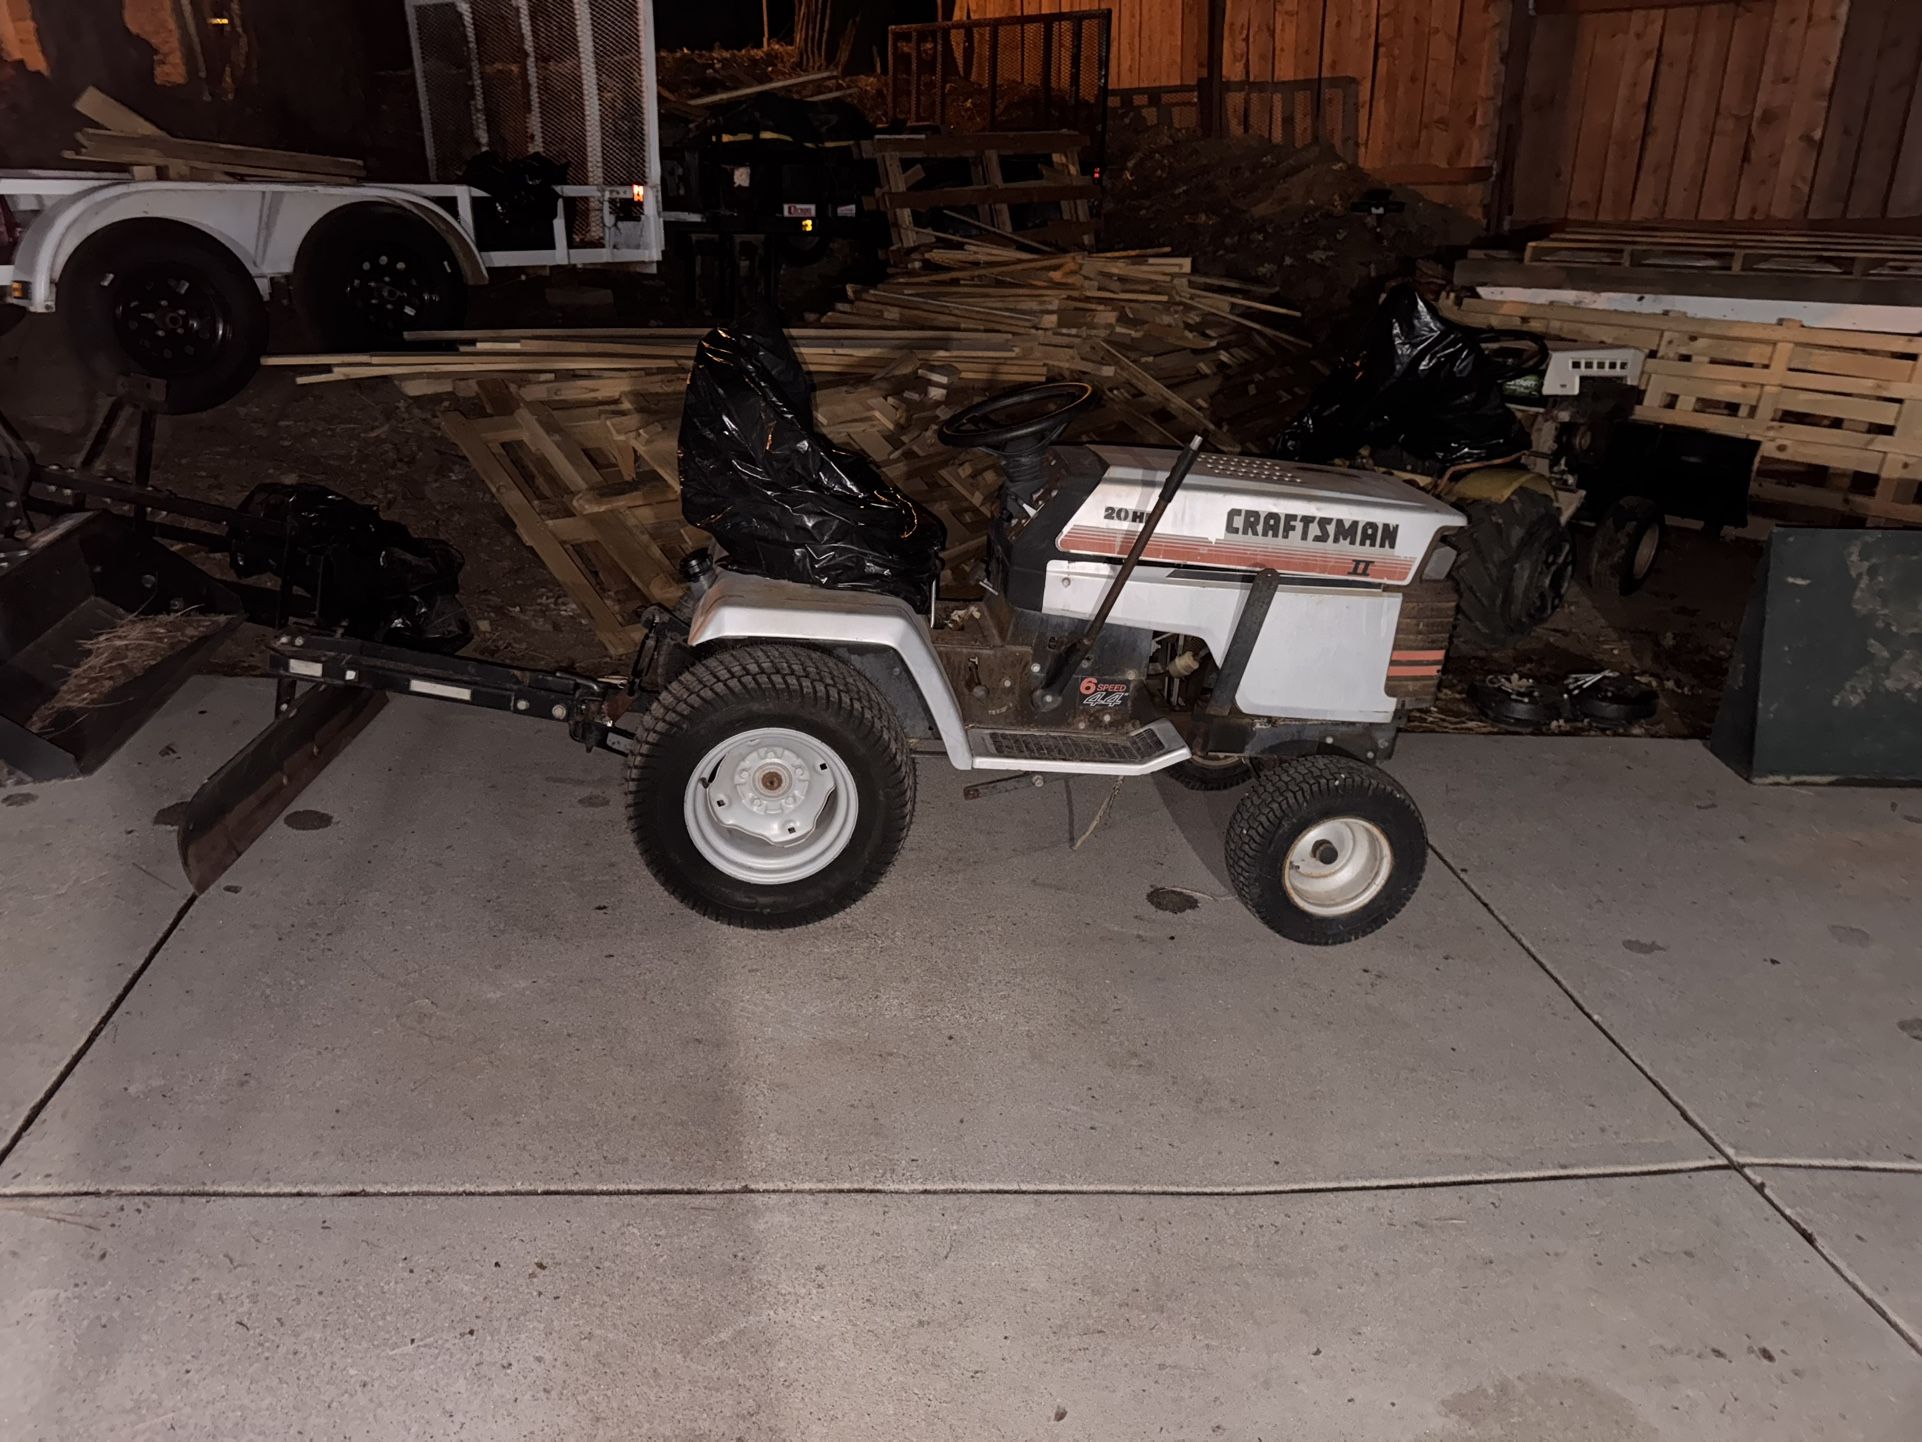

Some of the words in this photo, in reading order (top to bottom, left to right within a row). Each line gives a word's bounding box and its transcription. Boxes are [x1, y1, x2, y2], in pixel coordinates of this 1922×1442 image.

[1104, 506, 1130, 521] 20
[1225, 508, 1399, 549] CRAFTSMAN
[1347, 559, 1375, 577] II
[1080, 677, 1098, 695] 6
[1097, 684, 1127, 692] SPEED
